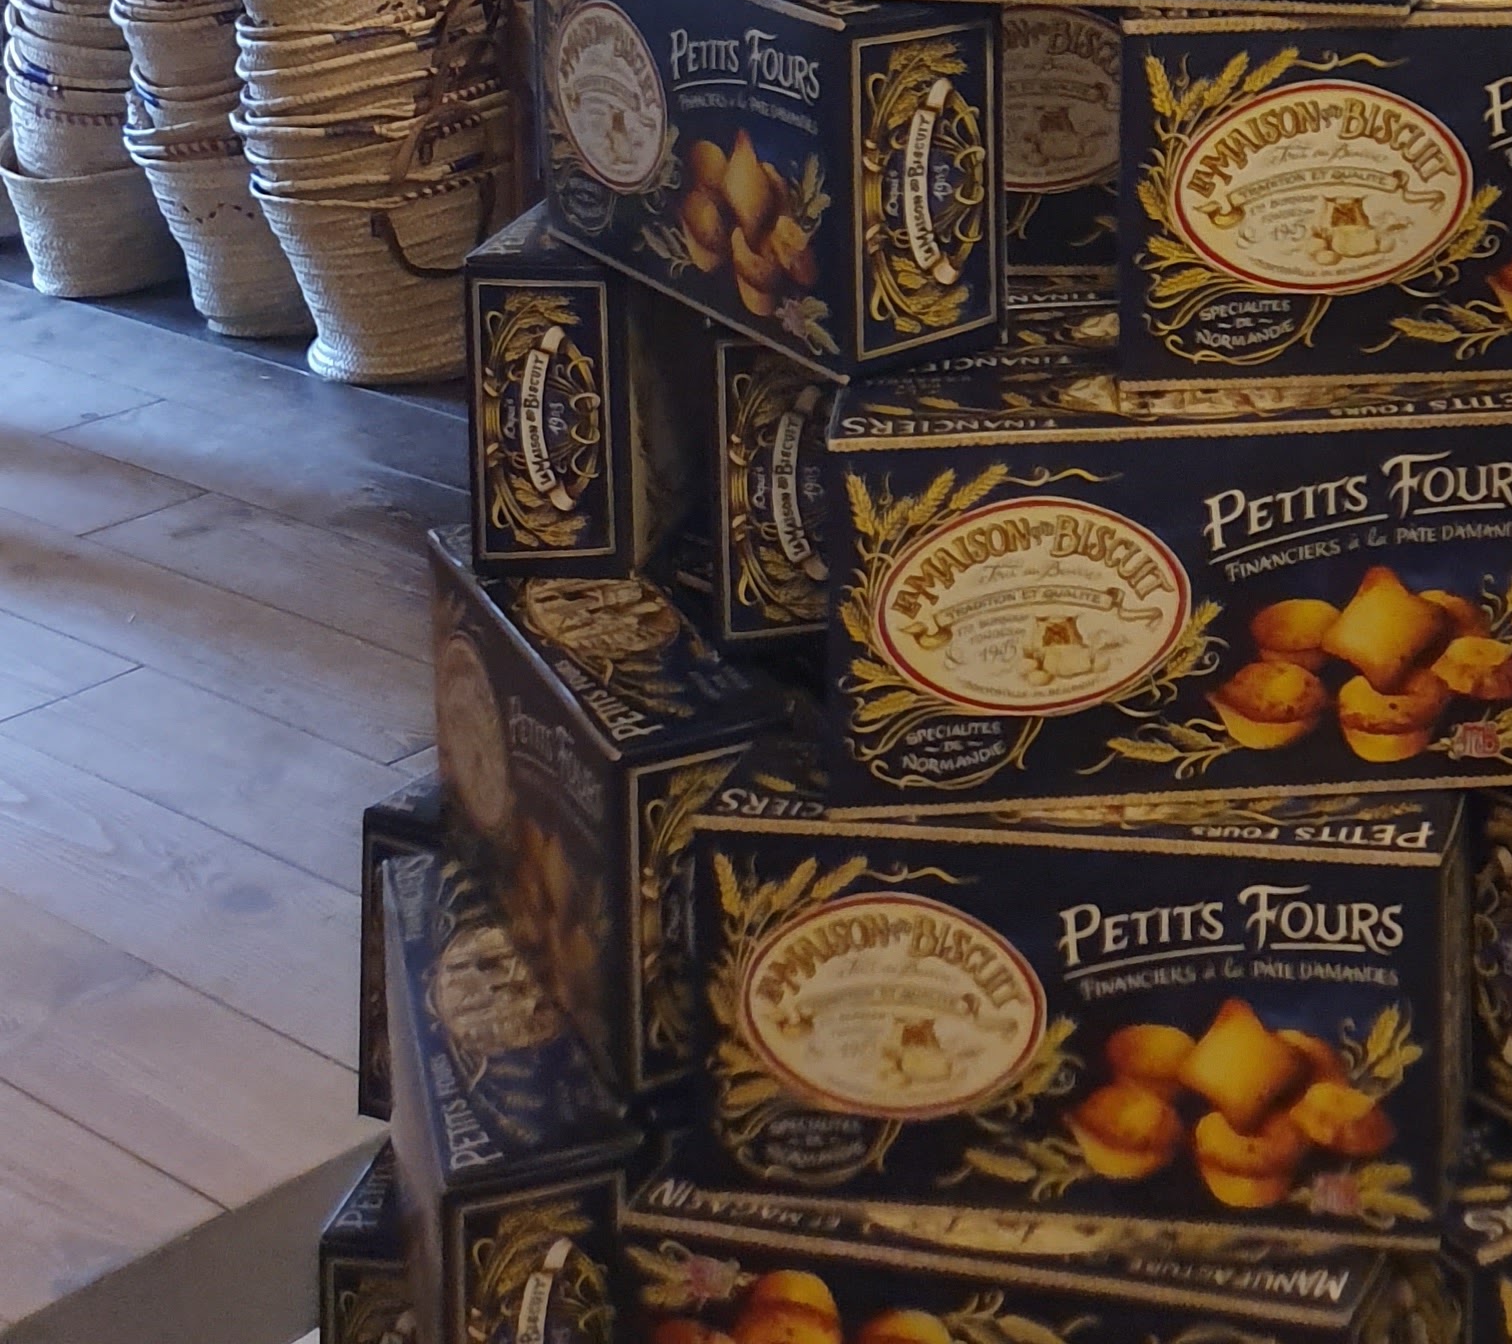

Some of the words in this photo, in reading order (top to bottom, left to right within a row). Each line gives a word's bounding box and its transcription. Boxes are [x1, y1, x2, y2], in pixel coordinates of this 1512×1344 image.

[669, 27, 740, 81] PETITS
[744, 28, 821, 108] FOURS
[906, 114, 931, 178] BISCUIT
[1200, 98, 1321, 186] MAISON
[1338, 96, 1457, 184] BISCUIT
[1195, 318, 1295, 350] NORMANDIE
[522, 354, 546, 410] BISCUIT
[774, 416, 801, 476] BISCUIT
[1202, 473, 1369, 553] PETITS
[904, 517, 1032, 607] MAISON
[1049, 514, 1176, 602] BISCUIT
[1224, 537, 1342, 584] FINANCIERS
[1365, 526, 1389, 548] la
[1021, 589, 1038, 599] ET
[582, 689, 665, 742] PETITS
[901, 739, 1007, 775] NORMANDIE
[1294, 822, 1432, 850] PETITS
[1057, 900, 1226, 969] PETITS
[1236, 883, 1405, 957] FOURS
